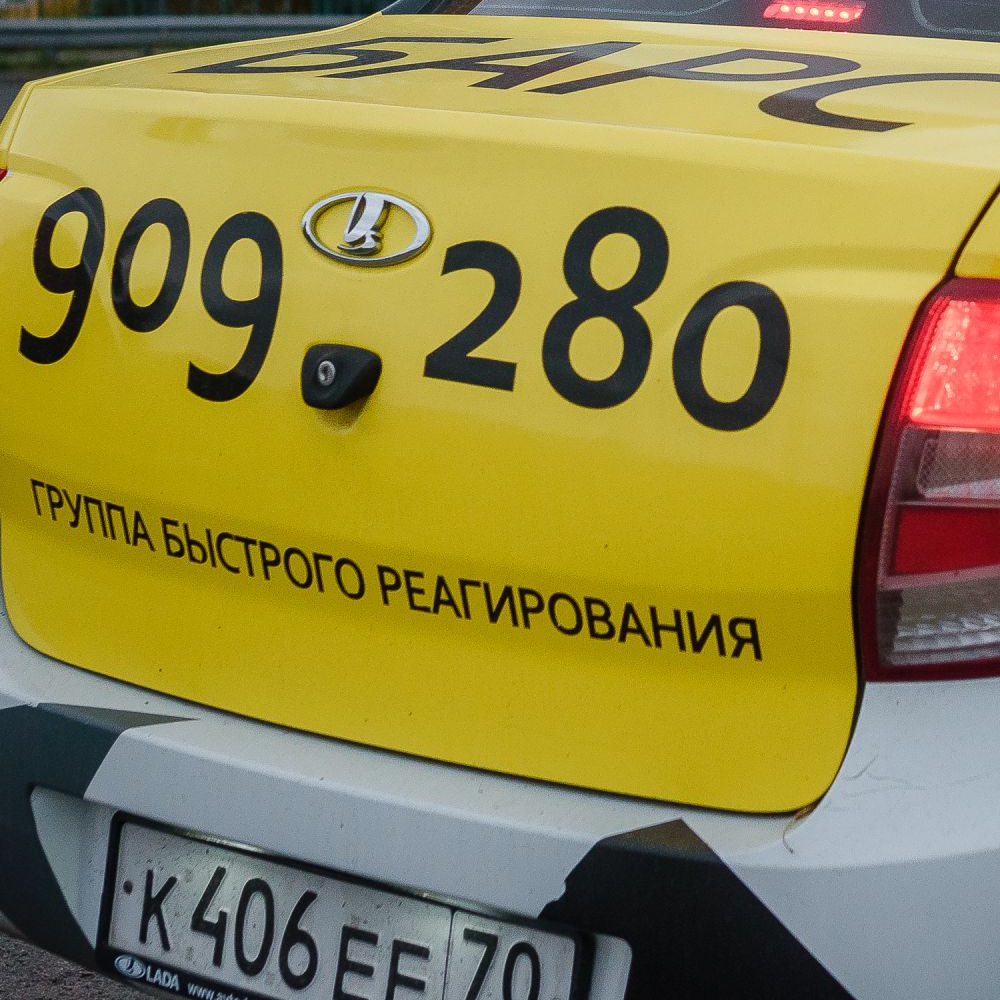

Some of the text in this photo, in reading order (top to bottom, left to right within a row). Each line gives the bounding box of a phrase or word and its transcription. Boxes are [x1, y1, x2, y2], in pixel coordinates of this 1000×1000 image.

[18, 186, 792, 432] 909 280
[30, 478, 763, 661] ГРУППА БЫСТРОГО РЕАГИРОВАНИЯ
[145, 965, 181, 992] LADA
